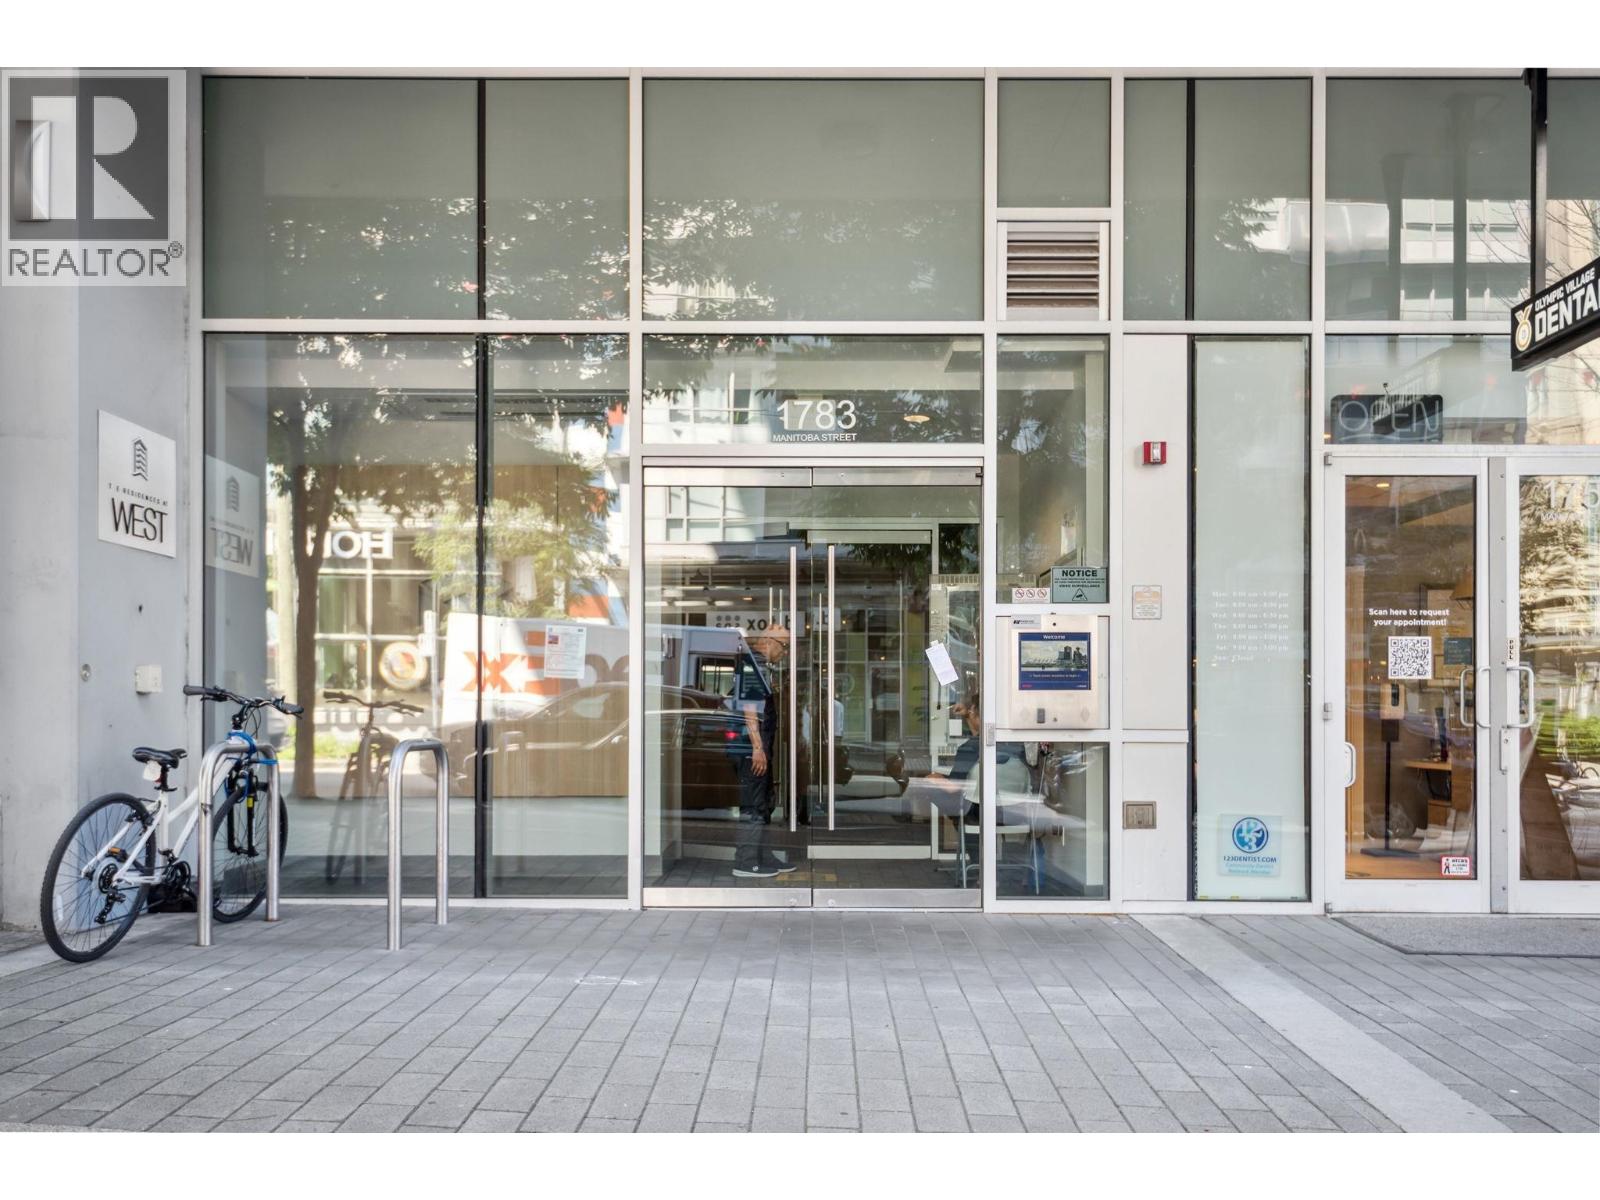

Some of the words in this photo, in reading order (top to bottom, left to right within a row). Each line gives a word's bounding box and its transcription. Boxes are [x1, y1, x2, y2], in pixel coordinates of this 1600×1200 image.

[1534, 285, 1565, 312] OLYMPIC
[1565, 267, 1596, 293] VILLAGE
[1534, 278, 1600, 342] DENTA
[776, 399, 857, 430] 1783
[772, 433, 820, 442] MANITOBA
[821, 432, 858, 442] STREET
[111, 497, 168, 543] WEST
[1061, 569, 1098, 577] NOTICE
[1368, 608, 1388, 616] Scan
[1389, 608, 1408, 616] here
[1419, 609, 1450, 617] request
[1393, 618, 1447, 627] appointment!
